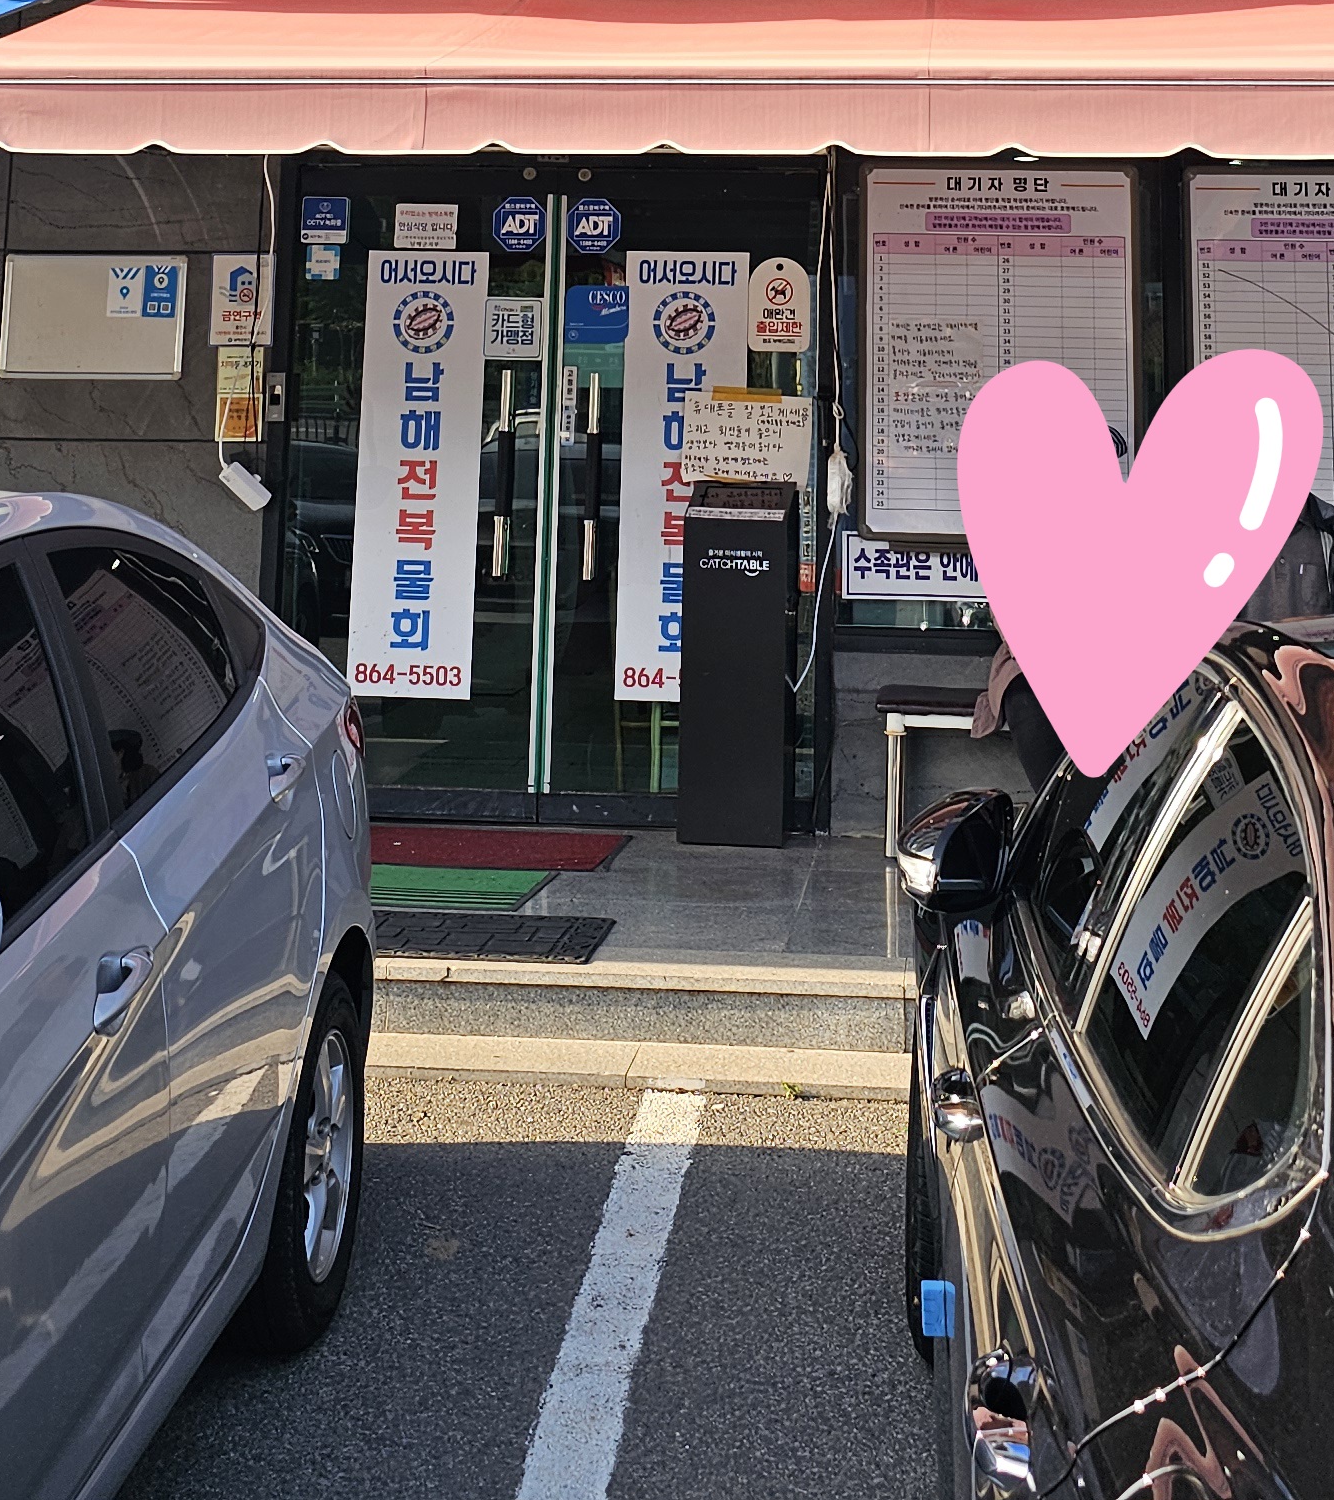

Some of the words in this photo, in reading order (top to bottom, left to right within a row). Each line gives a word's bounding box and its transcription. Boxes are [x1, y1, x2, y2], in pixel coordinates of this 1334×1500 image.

[946, 176, 1004, 192] 대기자
[1013, 177, 1050, 193] 명단
[1271, 182, 1332, 197] 대기자
[398, 222, 428, 232] 안심식당
[501, 214, 539, 234] ADT
[575, 215, 613, 236] ADT
[380, 259, 477, 286] 어서오시다
[639, 259, 737, 286] 어서오시다
[588, 290, 626, 304] CESCO
[491, 313, 535, 329] 카드형
[762, 308, 796, 320] 애완견
[756, 321, 803, 334] 출입제한
[490, 329, 534, 345] 가맹점
[693, 401, 735, 418] 휴대폰을
[744, 404, 754, 419] 잘
[759, 405, 774, 419] 보고
[687, 424, 710, 434] 그리고
[389, 361, 444, 651] 남해전복물회
[699, 558, 770, 571] CATCHTABLE
[853, 547, 932, 580] 수족관은
[354, 662, 462, 687] 864-5503
[623, 667, 681, 689] 864-
